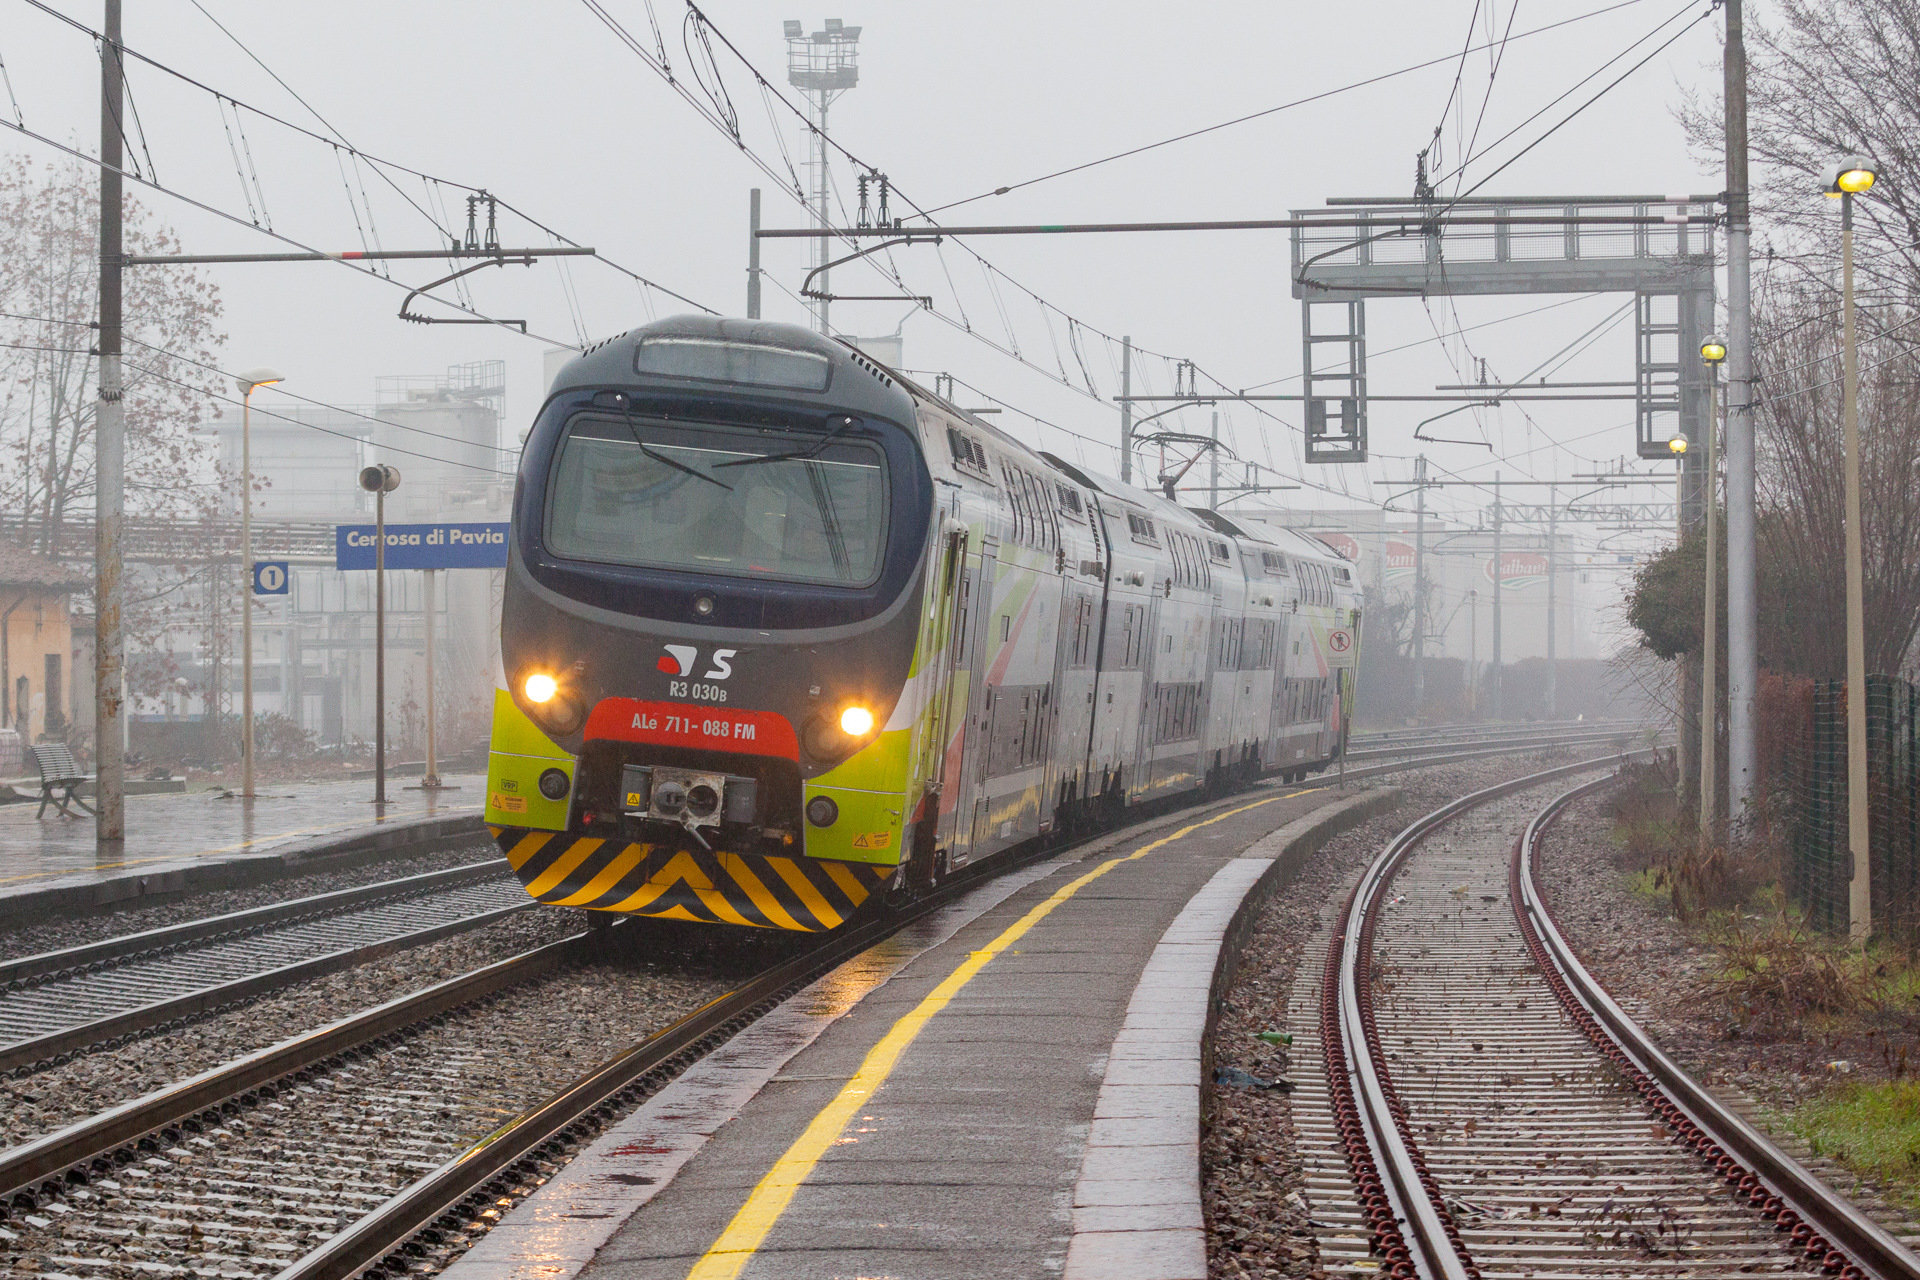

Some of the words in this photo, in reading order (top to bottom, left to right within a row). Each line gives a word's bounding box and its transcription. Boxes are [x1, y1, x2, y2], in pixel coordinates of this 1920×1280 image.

[426, 529, 444, 545] di
[450, 528, 504, 545] Pavia
[268, 570, 276, 586] 1
[704, 648, 737, 680] S
[669, 680, 688, 698] R3
[692, 683, 728, 702] 030B
[631, 713, 658, 730] ALe
[702, 719, 730, 737] 088
[734, 723, 756, 740] FM
